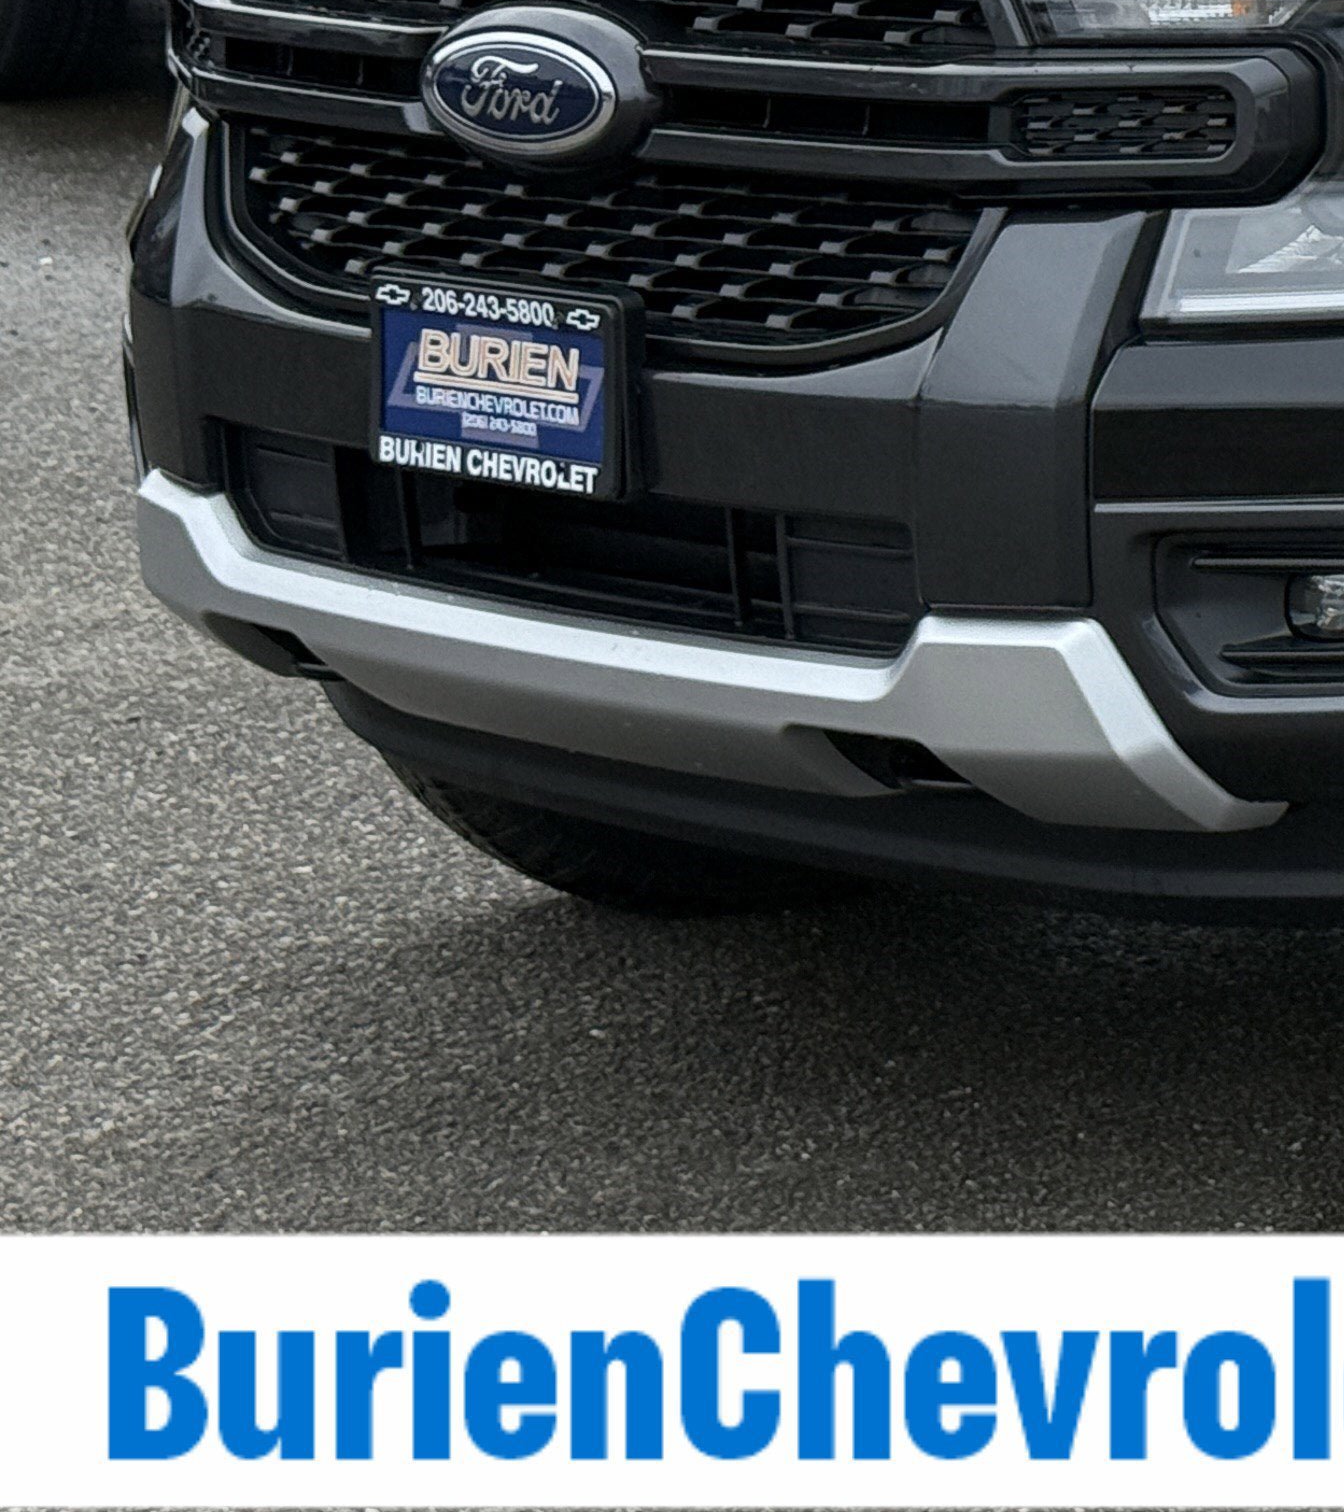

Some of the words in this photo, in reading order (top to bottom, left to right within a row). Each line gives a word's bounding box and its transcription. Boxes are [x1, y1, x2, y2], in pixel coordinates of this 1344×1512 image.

[461, 54, 563, 127] Ford
[421, 286, 555, 328] 206-243-5800
[418, 328, 580, 392] BURIEN
[415, 384, 580, 426] BURIENCHEVROLET.COM
[378, 434, 462, 474] BURIEN
[466, 448, 599, 495] CHEVROLET
